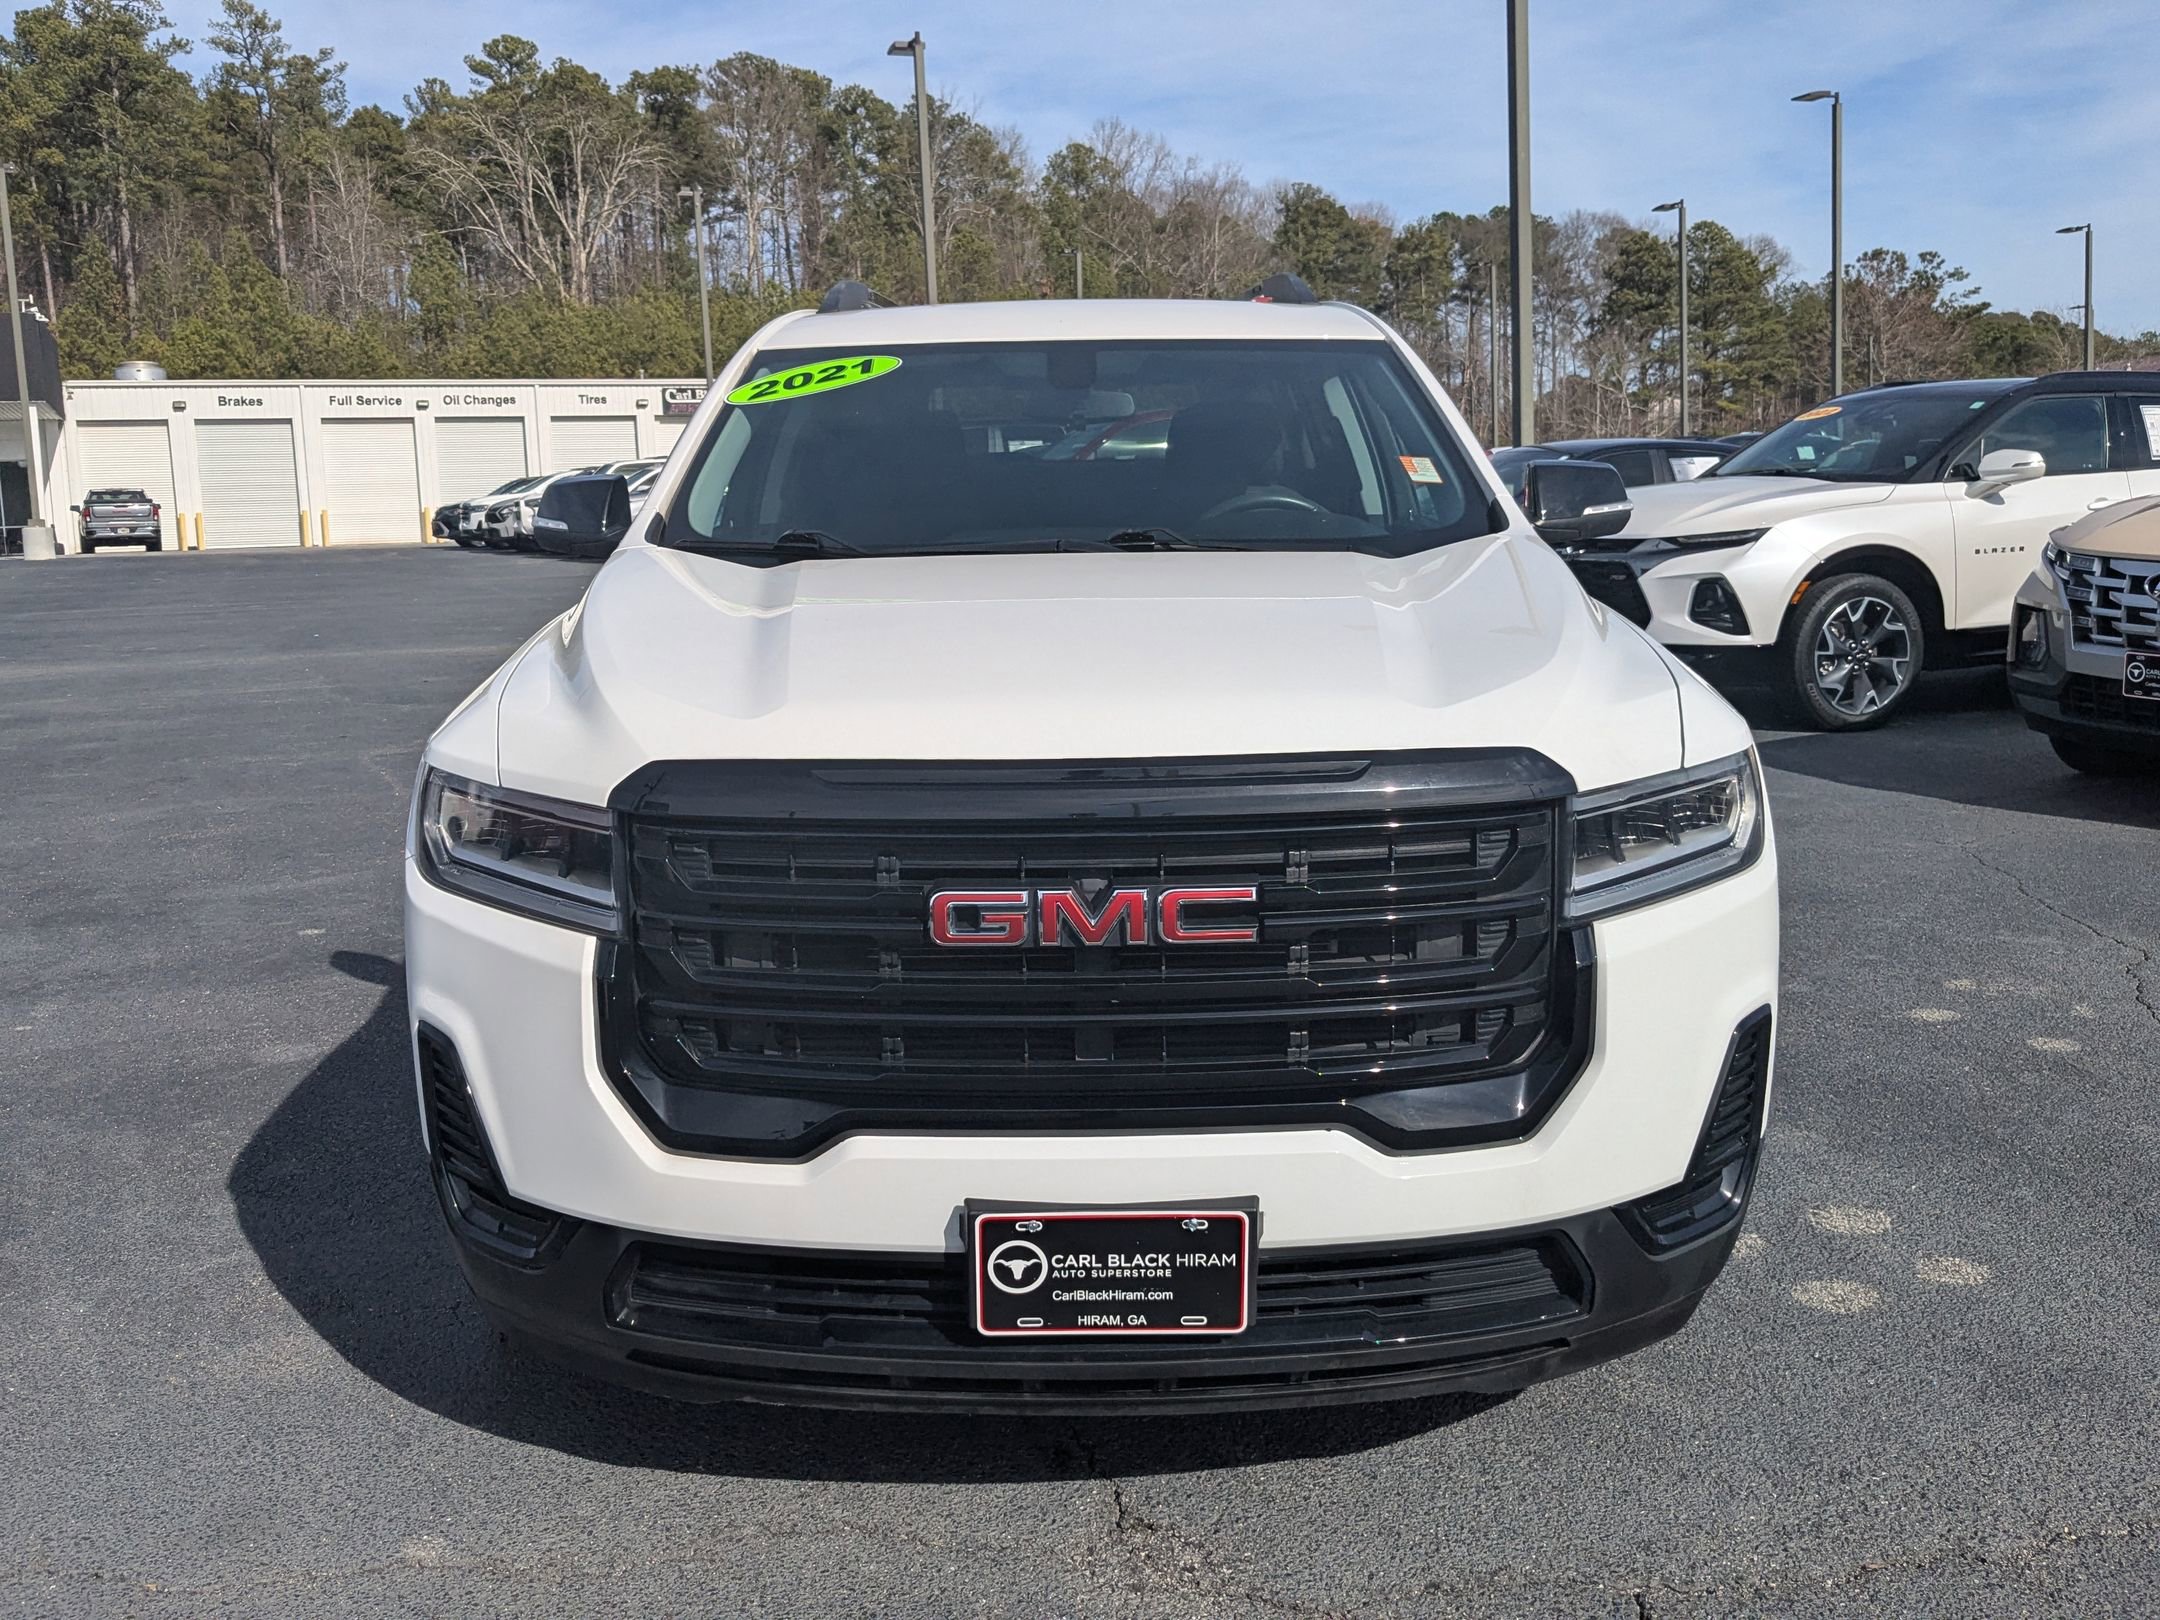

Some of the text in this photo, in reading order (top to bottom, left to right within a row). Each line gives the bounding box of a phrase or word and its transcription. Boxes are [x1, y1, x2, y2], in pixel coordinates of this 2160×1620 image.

[747, 358, 875, 401] 2021
[218, 396, 263, 407] Brakes
[329, 395, 402, 406] Full Service
[443, 395, 516, 407] Oil Changes
[578, 394, 607, 404] Tires
[665, 389, 692, 402] Carl
[1974, 546, 2025, 555] BLAZER
[930, 887, 1258, 946] GMC
[1051, 1253, 1236, 1268] CARL BLACK HIRAM
[1052, 1269, 1172, 1278] AUTO SUPERSTORE
[1052, 1289, 1173, 1301] CarlBlackHiram.com
[1077, 1315, 1147, 1327] HIRAM, GA
